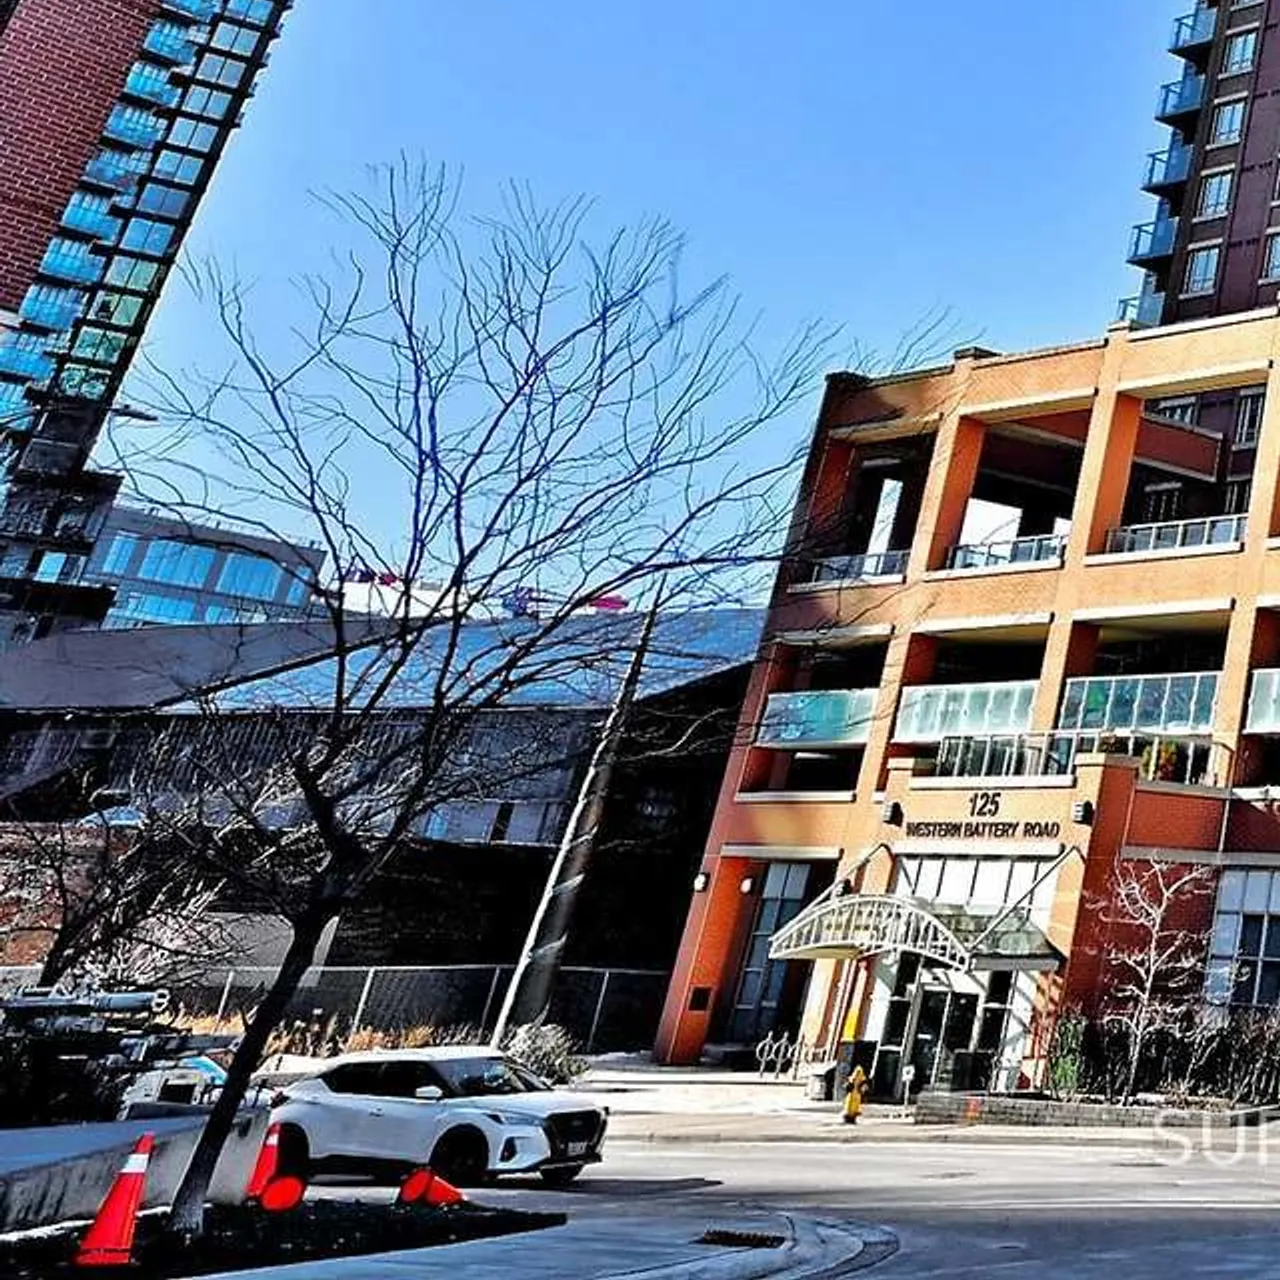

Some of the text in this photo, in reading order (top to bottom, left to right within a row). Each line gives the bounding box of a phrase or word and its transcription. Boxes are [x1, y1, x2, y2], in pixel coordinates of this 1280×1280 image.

[970, 792, 1001, 817] 125
[906, 822, 1061, 839] WESTERN BATTERY ROAD
